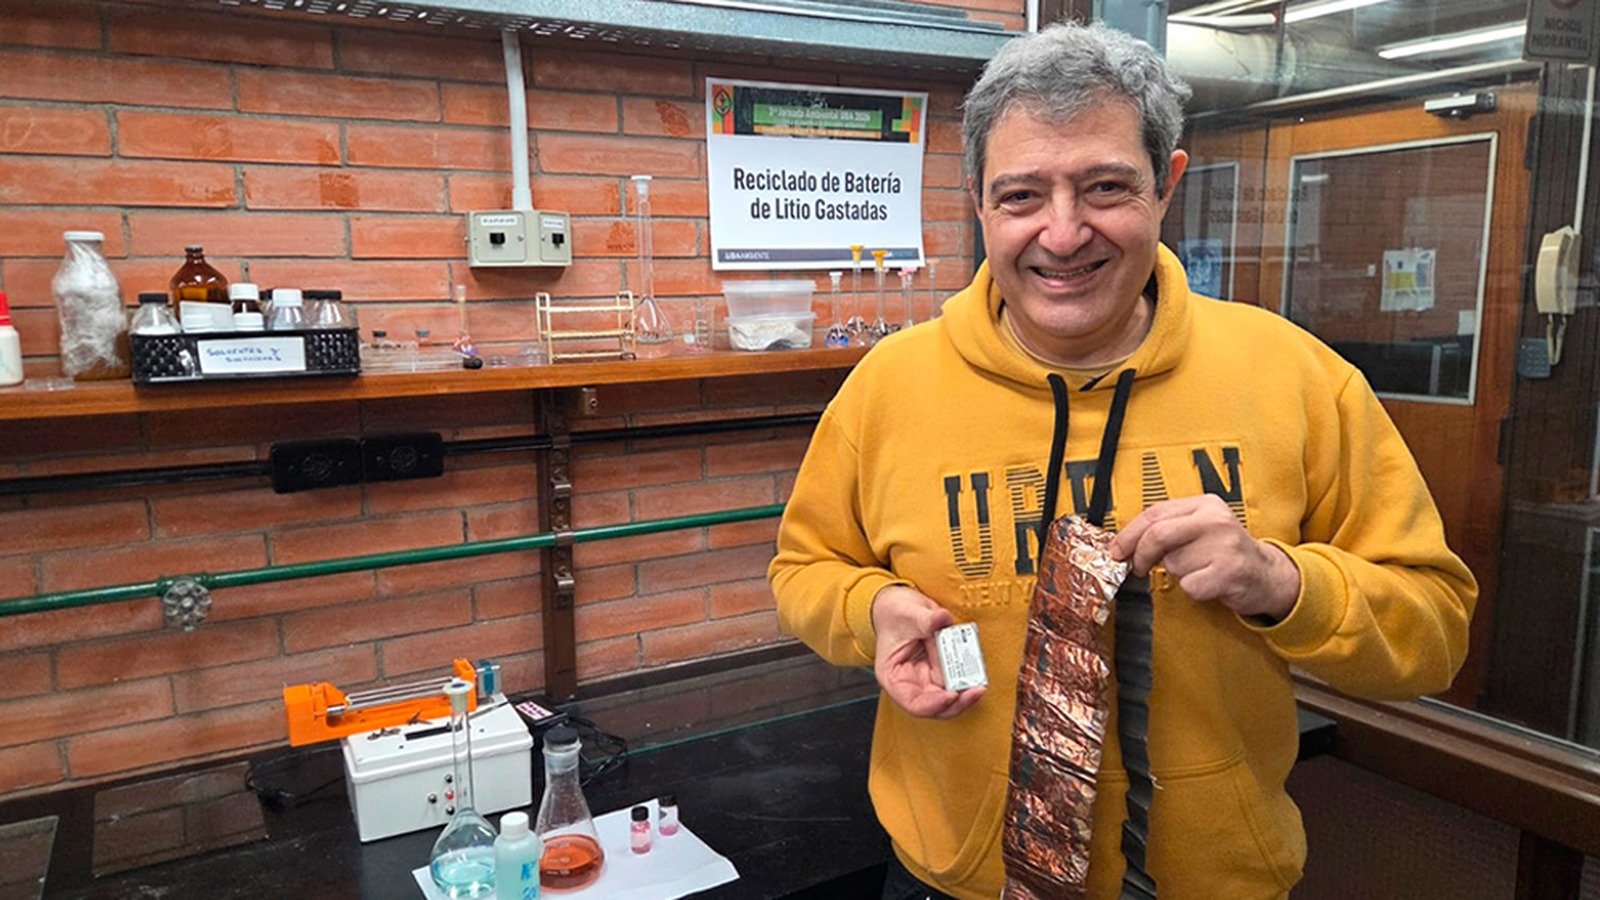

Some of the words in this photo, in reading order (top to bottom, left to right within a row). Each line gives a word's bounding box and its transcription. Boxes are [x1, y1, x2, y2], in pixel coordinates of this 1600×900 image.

[733, 167, 817, 193] Reciclado
[821, 171, 840, 193] de
[844, 171, 901, 194] Batería
[750, 197, 771, 220] de
[775, 197, 811, 220] Litio
[814, 198, 888, 221] Gastadas
